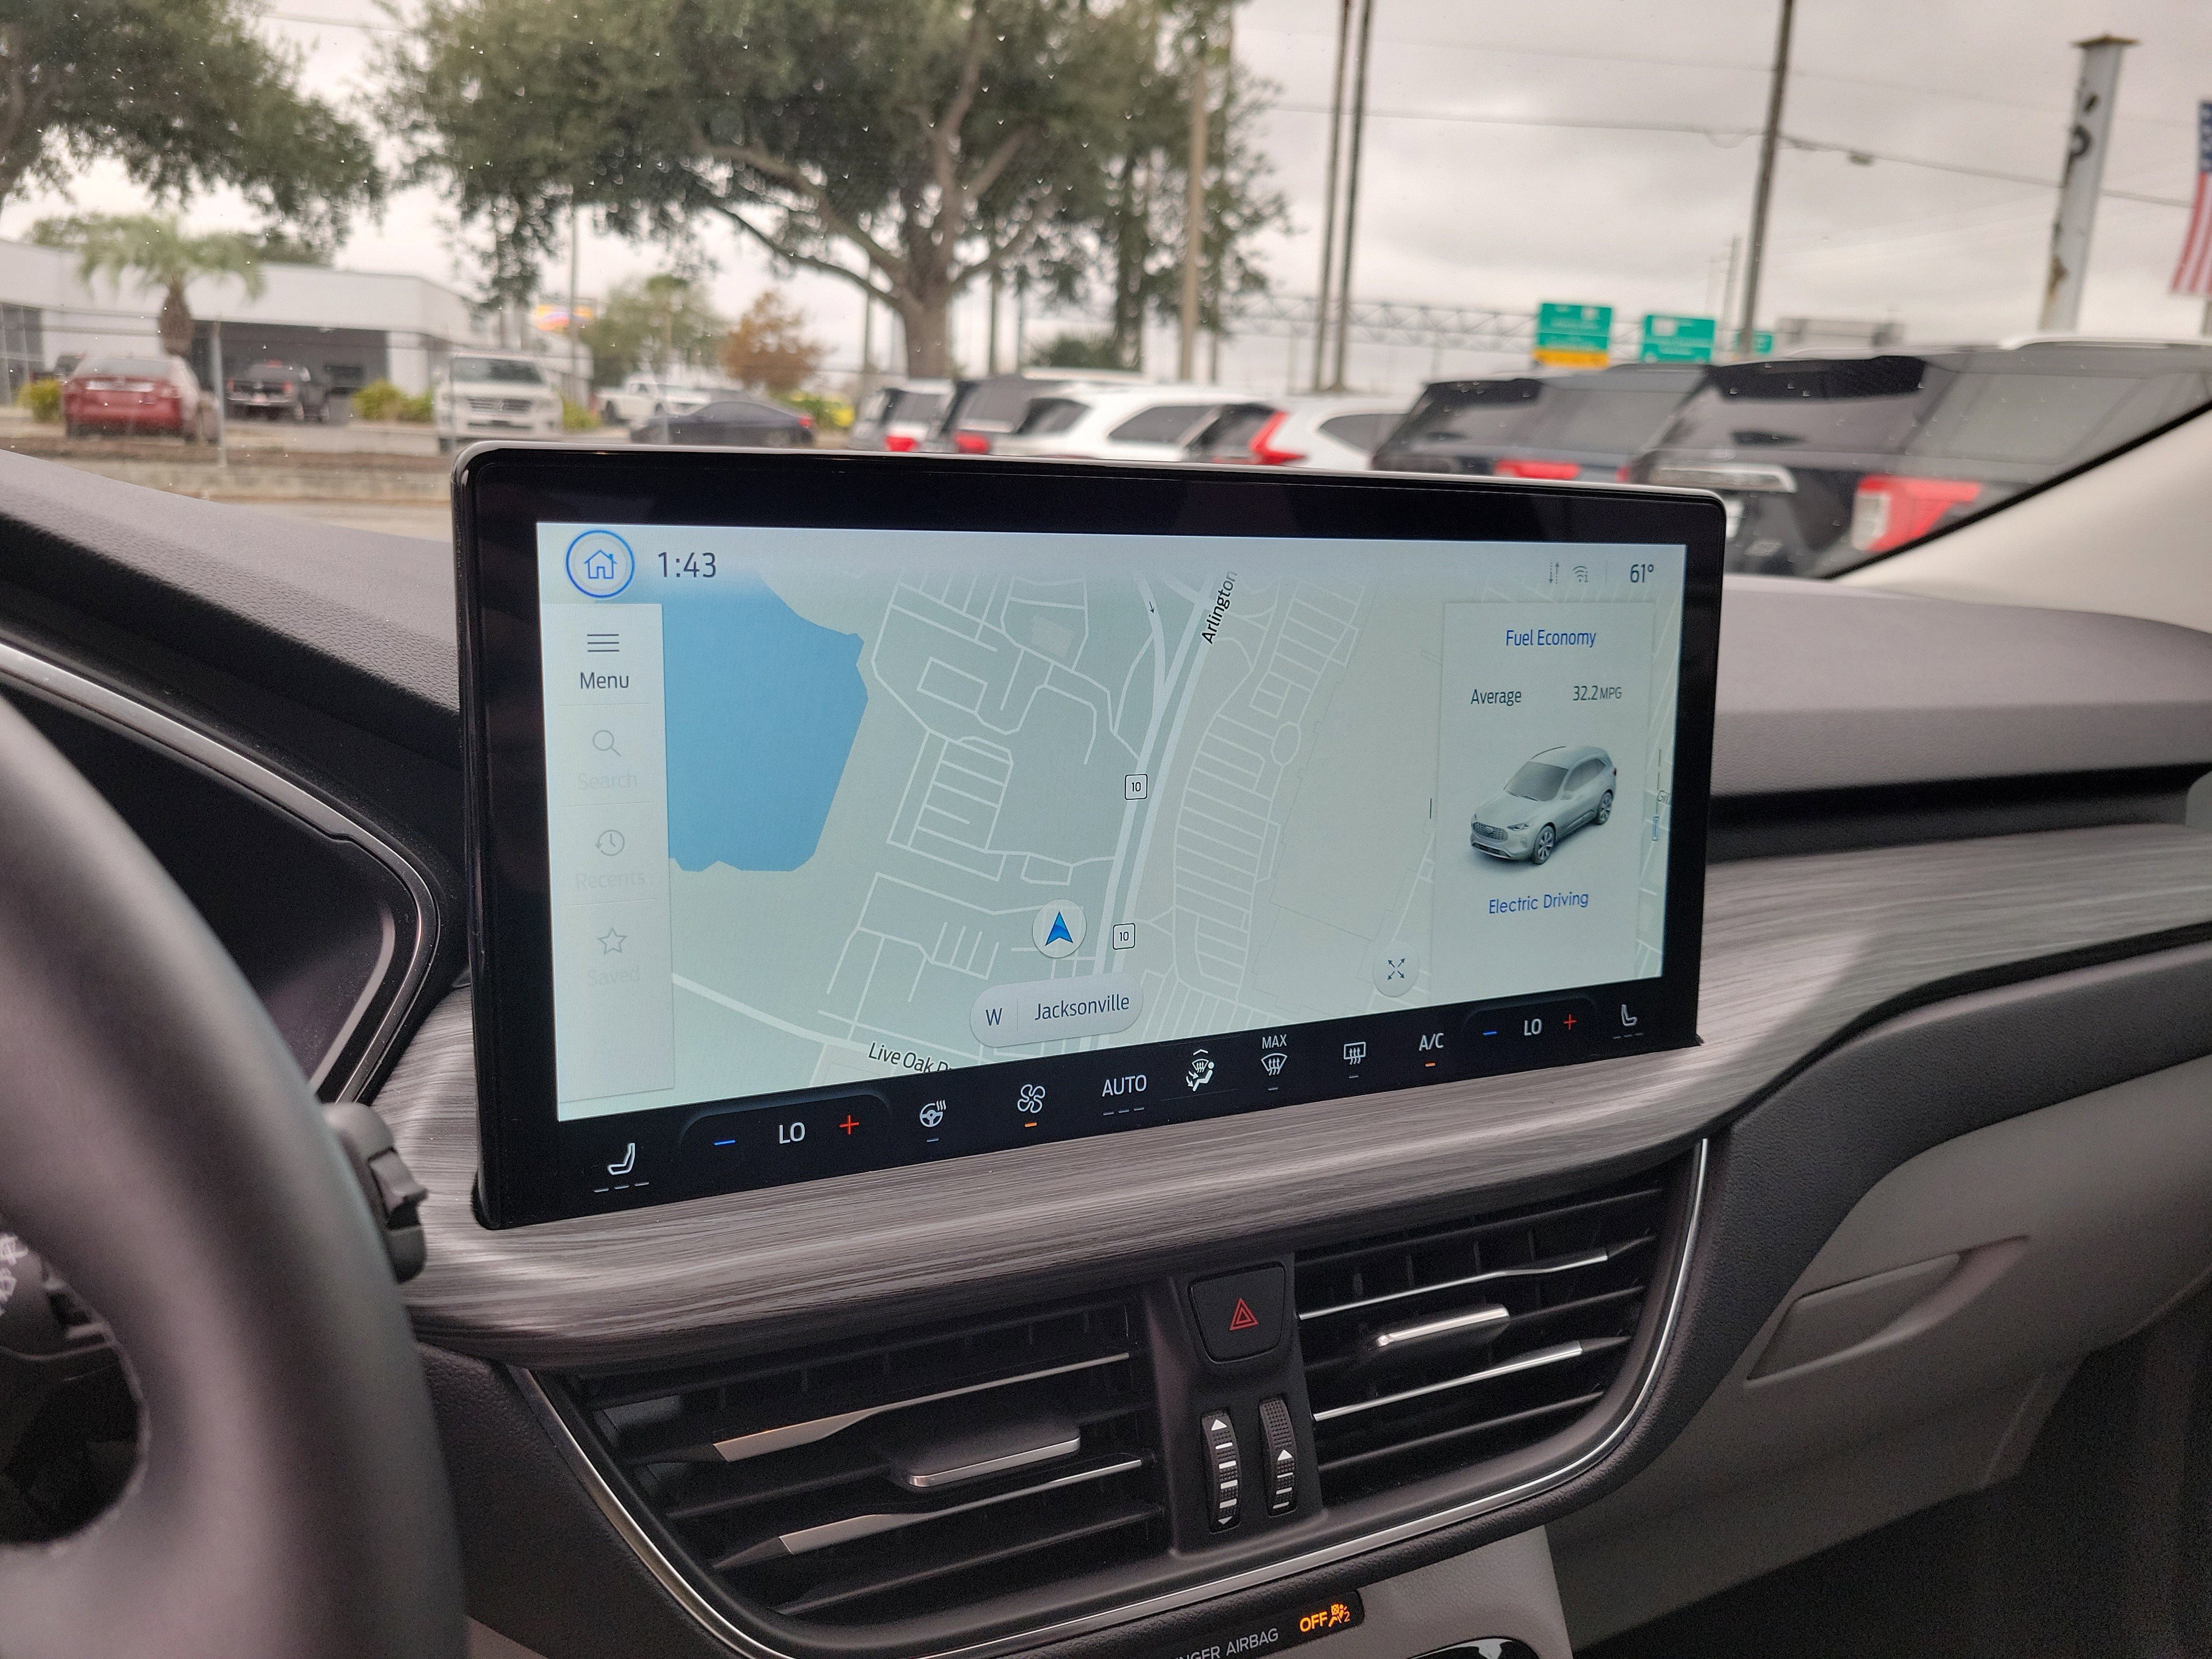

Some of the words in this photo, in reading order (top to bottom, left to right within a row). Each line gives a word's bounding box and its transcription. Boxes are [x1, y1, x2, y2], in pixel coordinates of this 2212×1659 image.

[657, 551, 717, 578] 1:43
[1629, 563, 1654, 583] 61°
[1200, 569, 1238, 645] Arlington
[1505, 629, 1534, 647] Fuel
[1537, 629, 1596, 648] Economy
[579, 671, 630, 690] Menu
[1470, 688, 1522, 707] Average
[578, 769, 638, 791] Search
[1131, 781, 1142, 793] 10
[1488, 894, 1538, 915] Electric
[1543, 891, 1589, 911] Driving
[1119, 930, 1130, 943] 10
[985, 1008, 1003, 1027] W
[1034, 993, 1130, 1022] Jacksonville
[1523, 1018, 1543, 1036] LO
[1261, 1034, 1288, 1050] MAX
[1418, 1032, 1444, 1052] A/C
[868, 1042, 901, 1065] Live
[903, 1052, 934, 1073] Oak
[936, 1060, 952, 1072] D
[1102, 1074, 1147, 1097] AUTO
[778, 1121, 806, 1144] LO
[1299, 1611, 1328, 1633] OFF
[1226, 1627, 1279, 1656] AIRBAG
